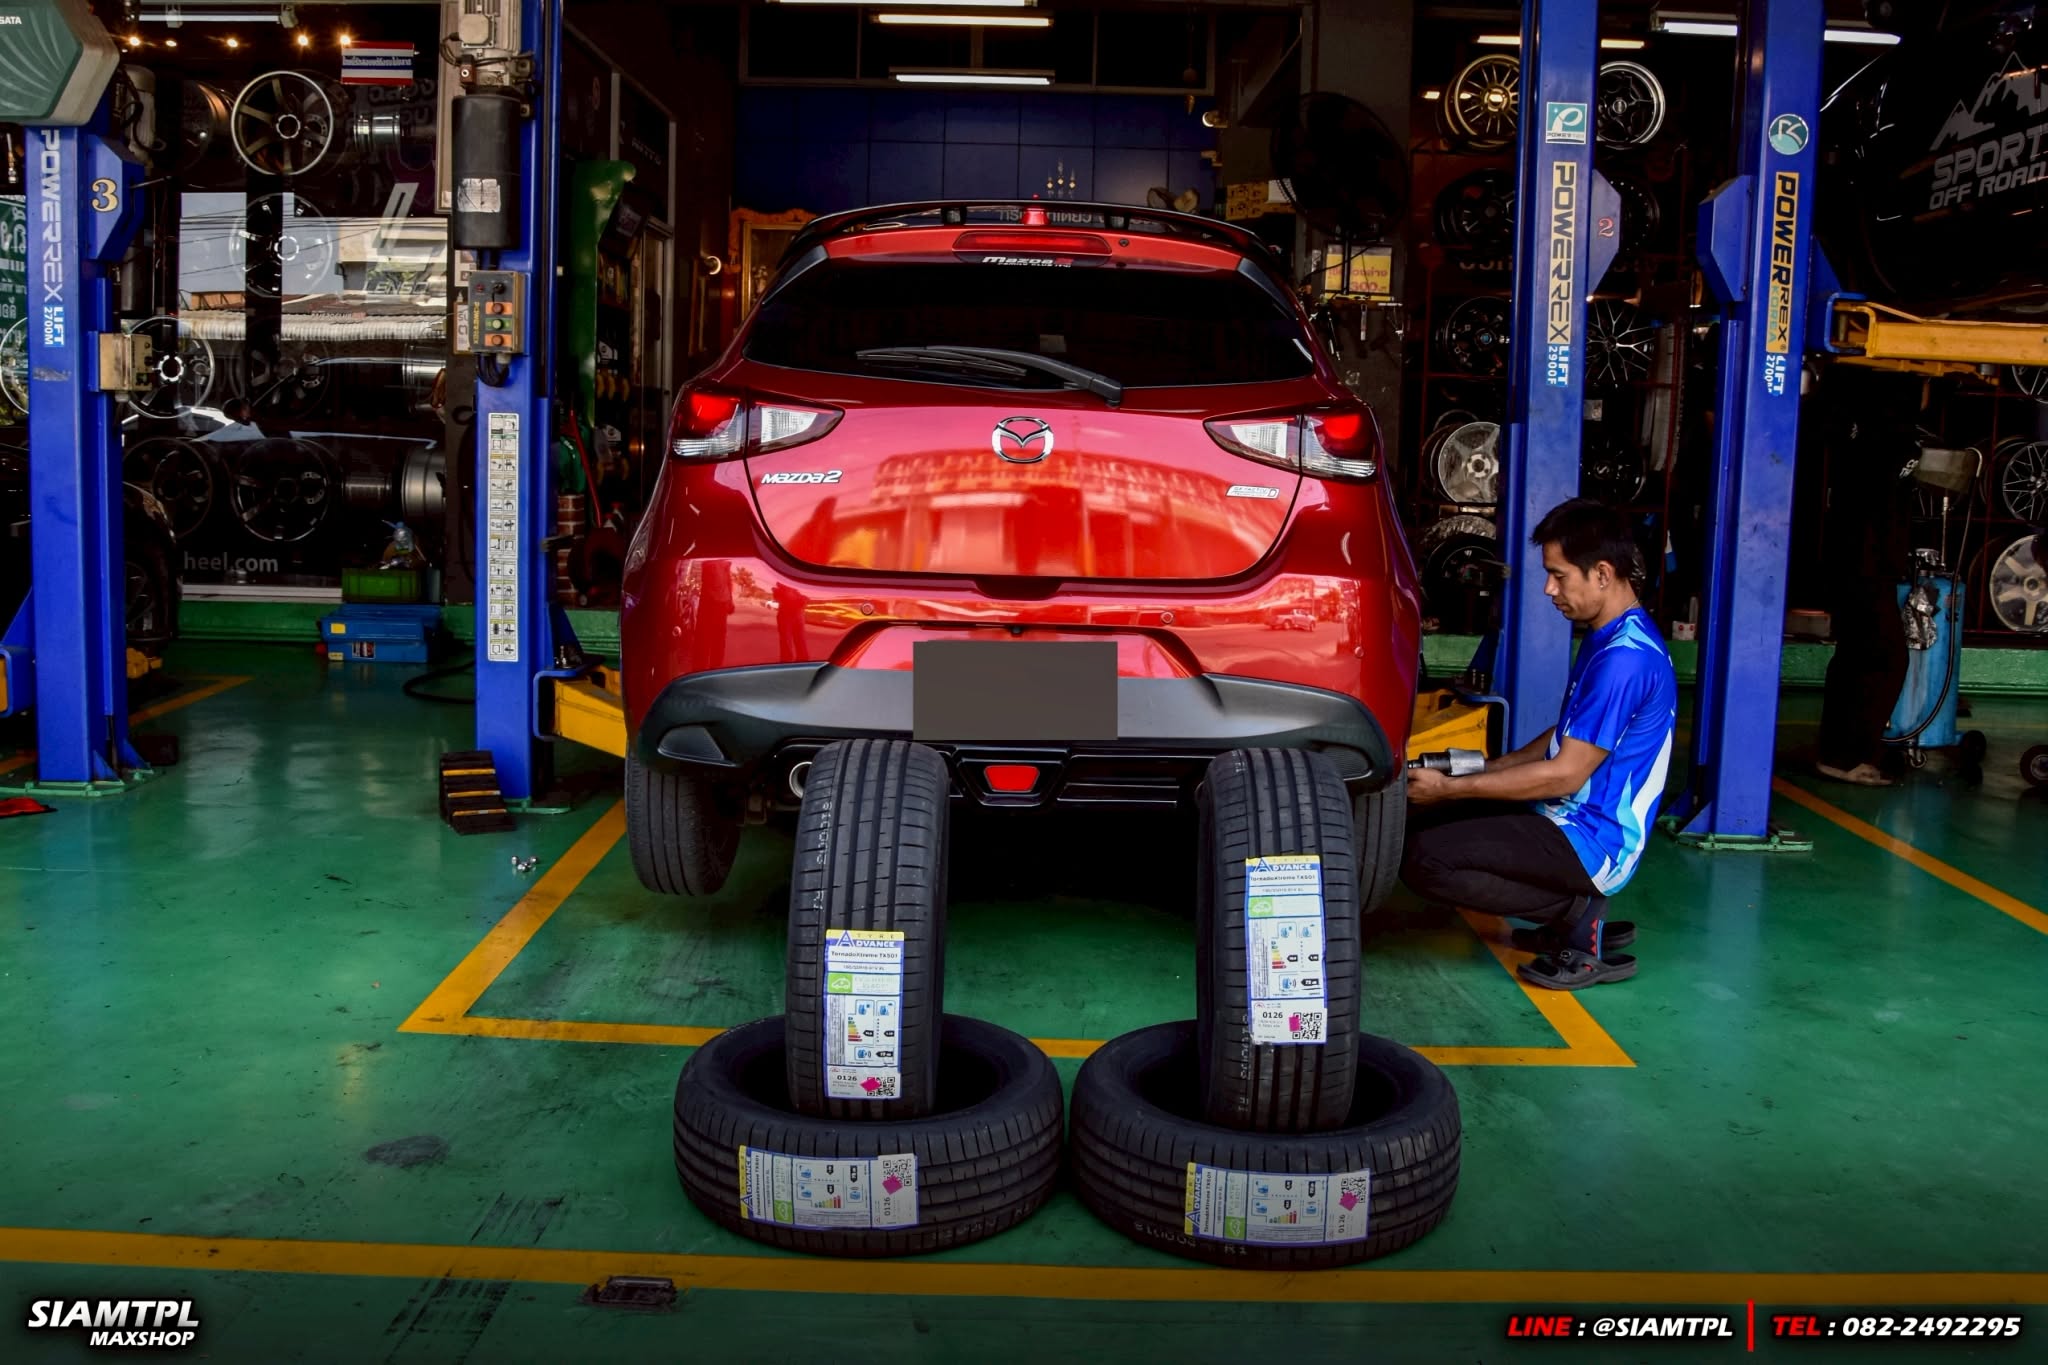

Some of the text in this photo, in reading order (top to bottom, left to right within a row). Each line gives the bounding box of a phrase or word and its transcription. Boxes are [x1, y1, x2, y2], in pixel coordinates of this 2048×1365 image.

[91, 178, 119, 212] 3
[1929, 161, 2047, 210] OFF ROAD
[41, 129, 63, 302] POWERREX
[1598, 217, 1614, 238] 2
[1550, 165, 1575, 342] POWERREX
[1771, 174, 1797, 342] POWERREX
[44, 307, 54, 345] 2700M
[53, 307, 64, 345] LIFT
[1768, 285, 1780, 343] KOREA
[1547, 346, 1558, 385] 2900F
[1558, 345, 1569, 385] LIFT
[1773, 355, 1786, 395] LIFT
[1253, 857, 1312, 872] ADVANCE
[836, 930, 895, 948] ADVANCE
[1262, 1011, 1284, 1019] 0126
